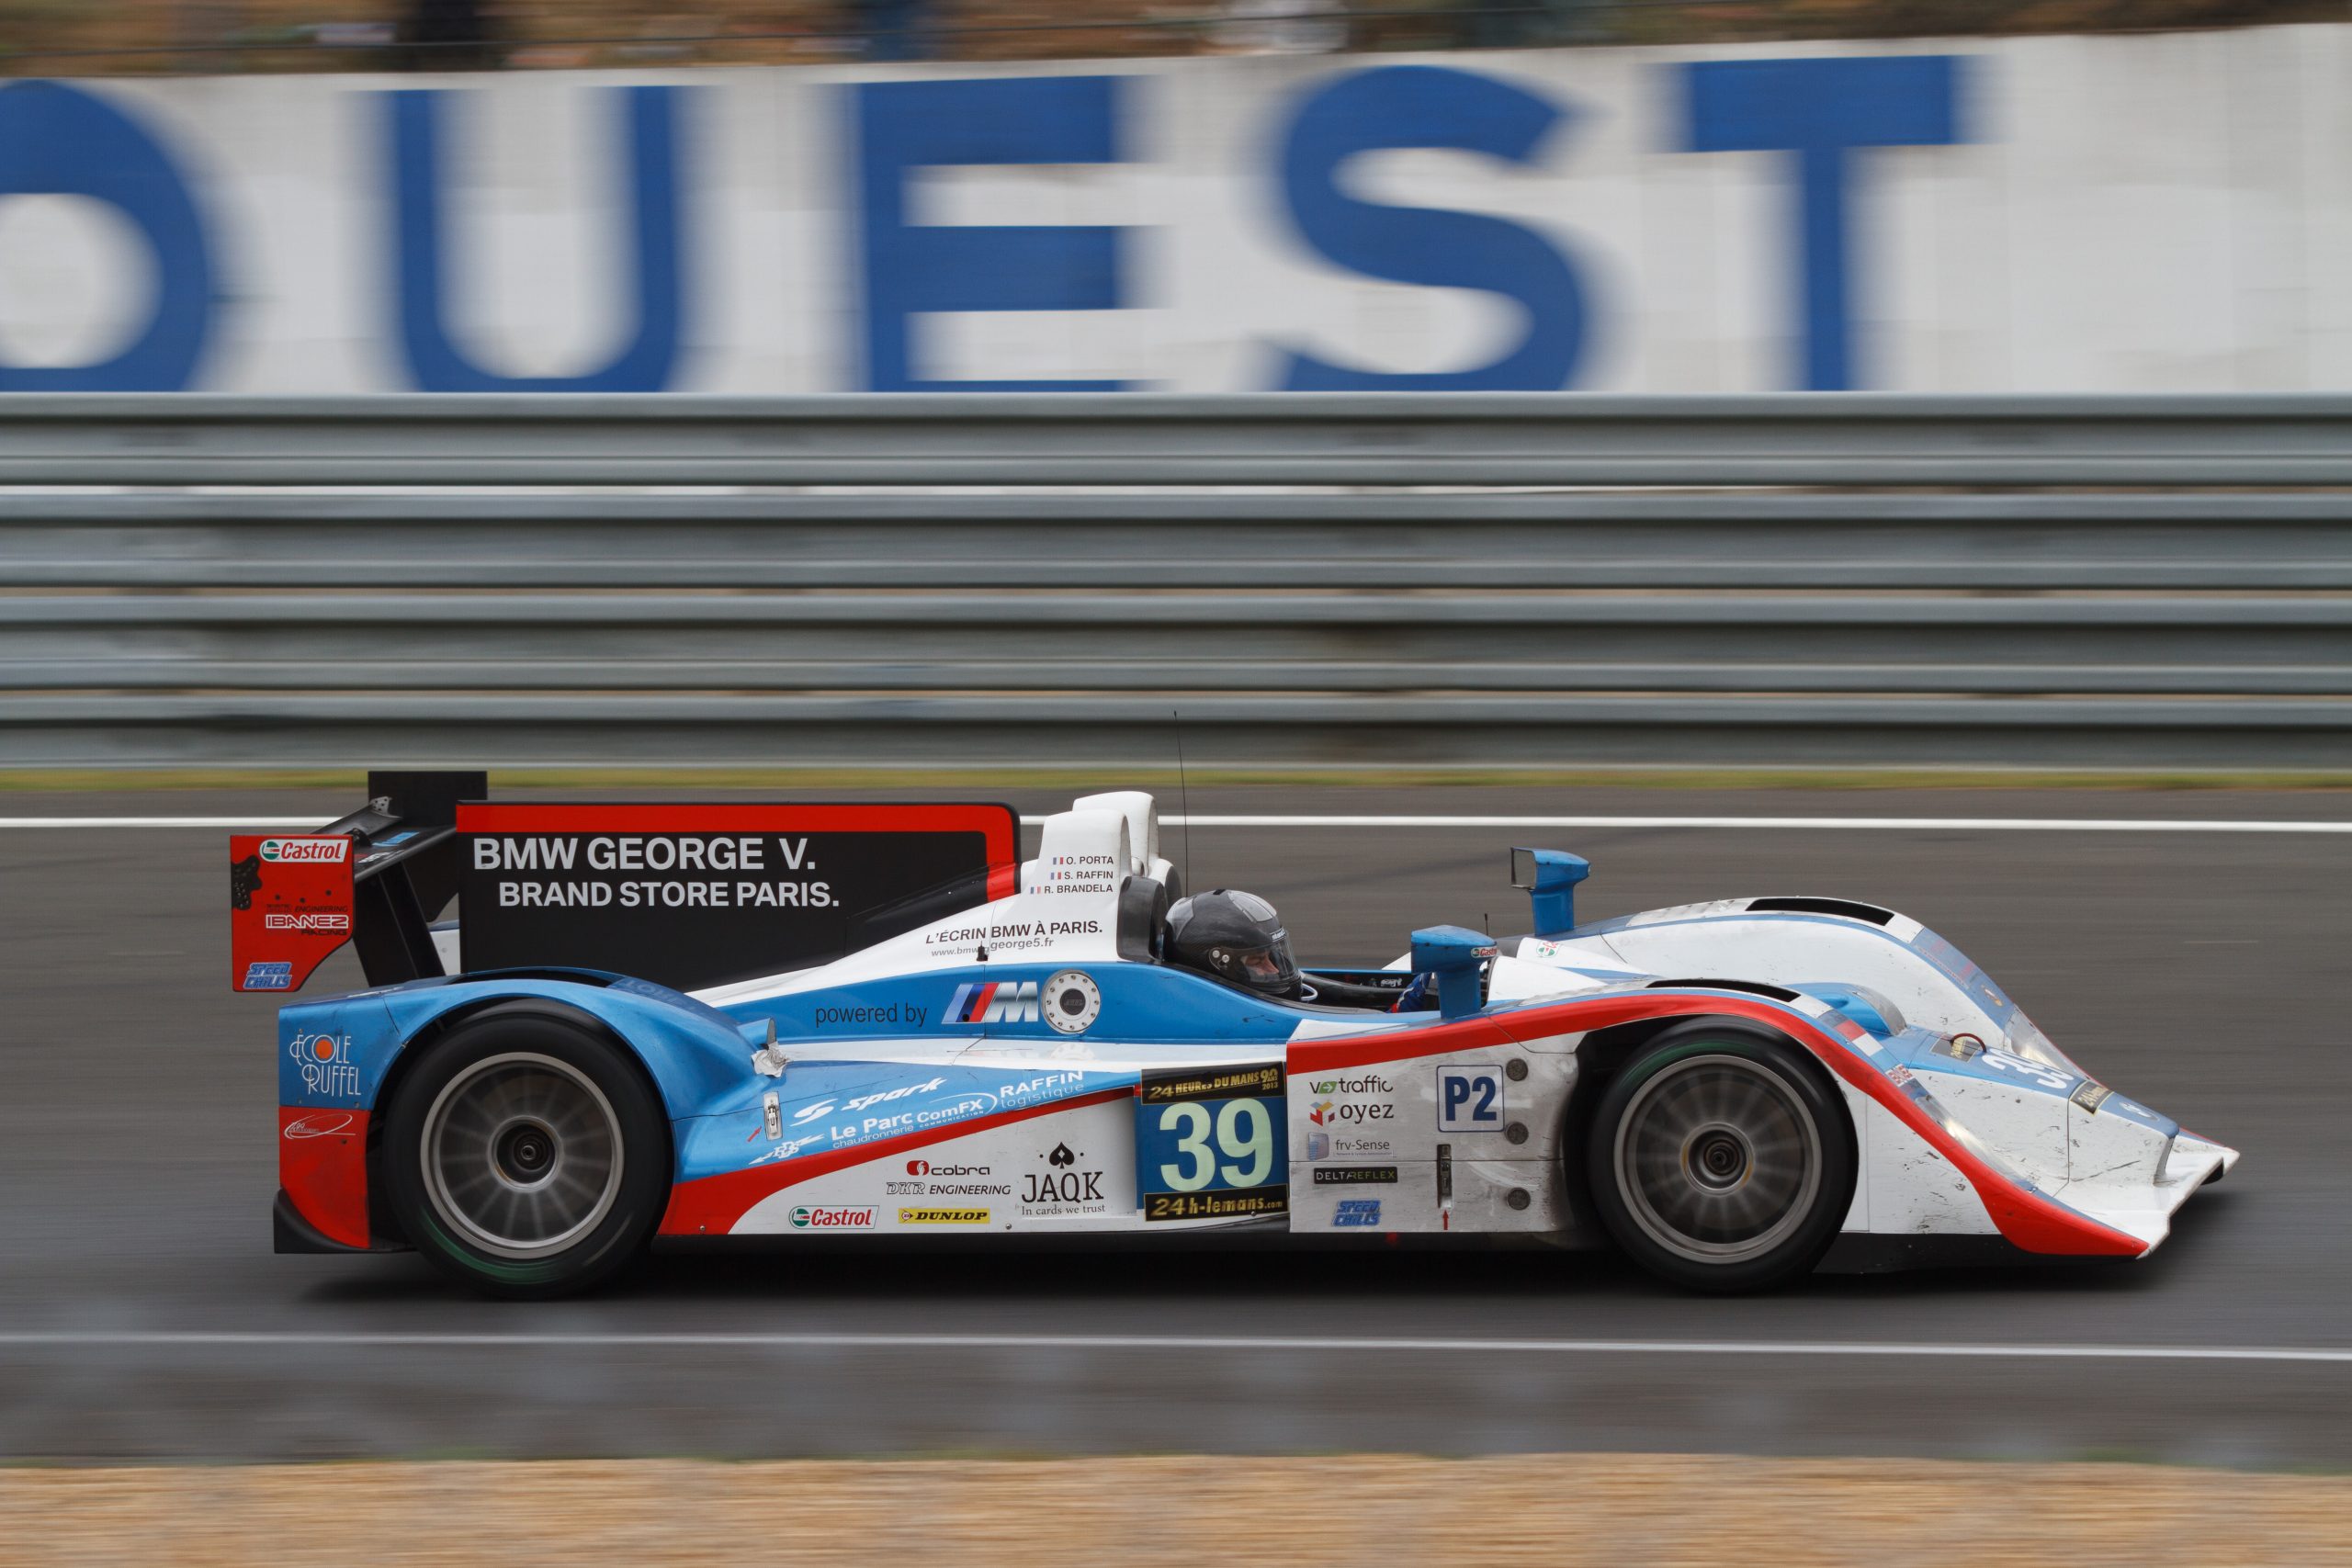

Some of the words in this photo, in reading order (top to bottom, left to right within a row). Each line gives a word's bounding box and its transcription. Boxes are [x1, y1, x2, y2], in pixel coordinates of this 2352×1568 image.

[281, 840, 343, 861] Castrol
[473, 837, 579, 870] BMW
[587, 836, 764, 871] GEORGE
[778, 837, 816, 870] V.
[1066, 856, 1077, 865] O.
[1079, 855, 1114, 864] PORTA
[1064, 871, 1074, 880] S.
[1076, 870, 1114, 880] RAFFIN
[498, 881, 613, 907] BRAND
[619, 880, 729, 908] STORE
[737, 881, 840, 908] PARIS.
[1044, 886, 1054, 895] R.
[1056, 884, 1114, 894] BRANDELA
[265, 914, 349, 929] IBANEZ
[991, 924, 1031, 938] BMW
[1035, 920, 1046, 935] À
[1049, 920, 1102, 935] PARIS.
[815, 1002, 898, 1028] powered
[904, 1002, 927, 1027] by
[841, 1077, 948, 1111] spark
[1000, 1070, 1083, 1098] RAFFIN
[1149, 1084, 1175, 1100] 24
[1214, 1077, 1228, 1088] DU
[1230, 1072, 1260, 1086] MANS
[1261, 1082, 1279, 1091] 2013
[1338, 1075, 1394, 1094] traffic
[1001, 1083, 1085, 1108] logistique
[1443, 1075, 1498, 1122] P2
[917, 1099, 984, 1123] ComFX
[919, 1110, 985, 1128] COMMUNICATION
[1340, 1104, 1395, 1124] oyez
[831, 1126, 856, 1141] Le
[863, 1112, 912, 1134] Parc
[832, 1124, 914, 1149] chaudronnerie
[1159, 1098, 1274, 1192] 39
[1335, 1139, 1390, 1151] frv-Sense
[931, 1164, 990, 1176] cobra
[886, 1181, 926, 1195] DKR
[929, 1184, 1012, 1195] ENGINEERING
[1021, 1171, 1104, 1204] JAQK
[810, 1207, 872, 1226] Castrol
[914, 1211, 988, 1221] DUNLOP
[1022, 1205, 1032, 1216] In
[1035, 1204, 1062, 1215] cards
[1066, 1206, 1080, 1214] we
[1082, 1203, 1106, 1214] trust
